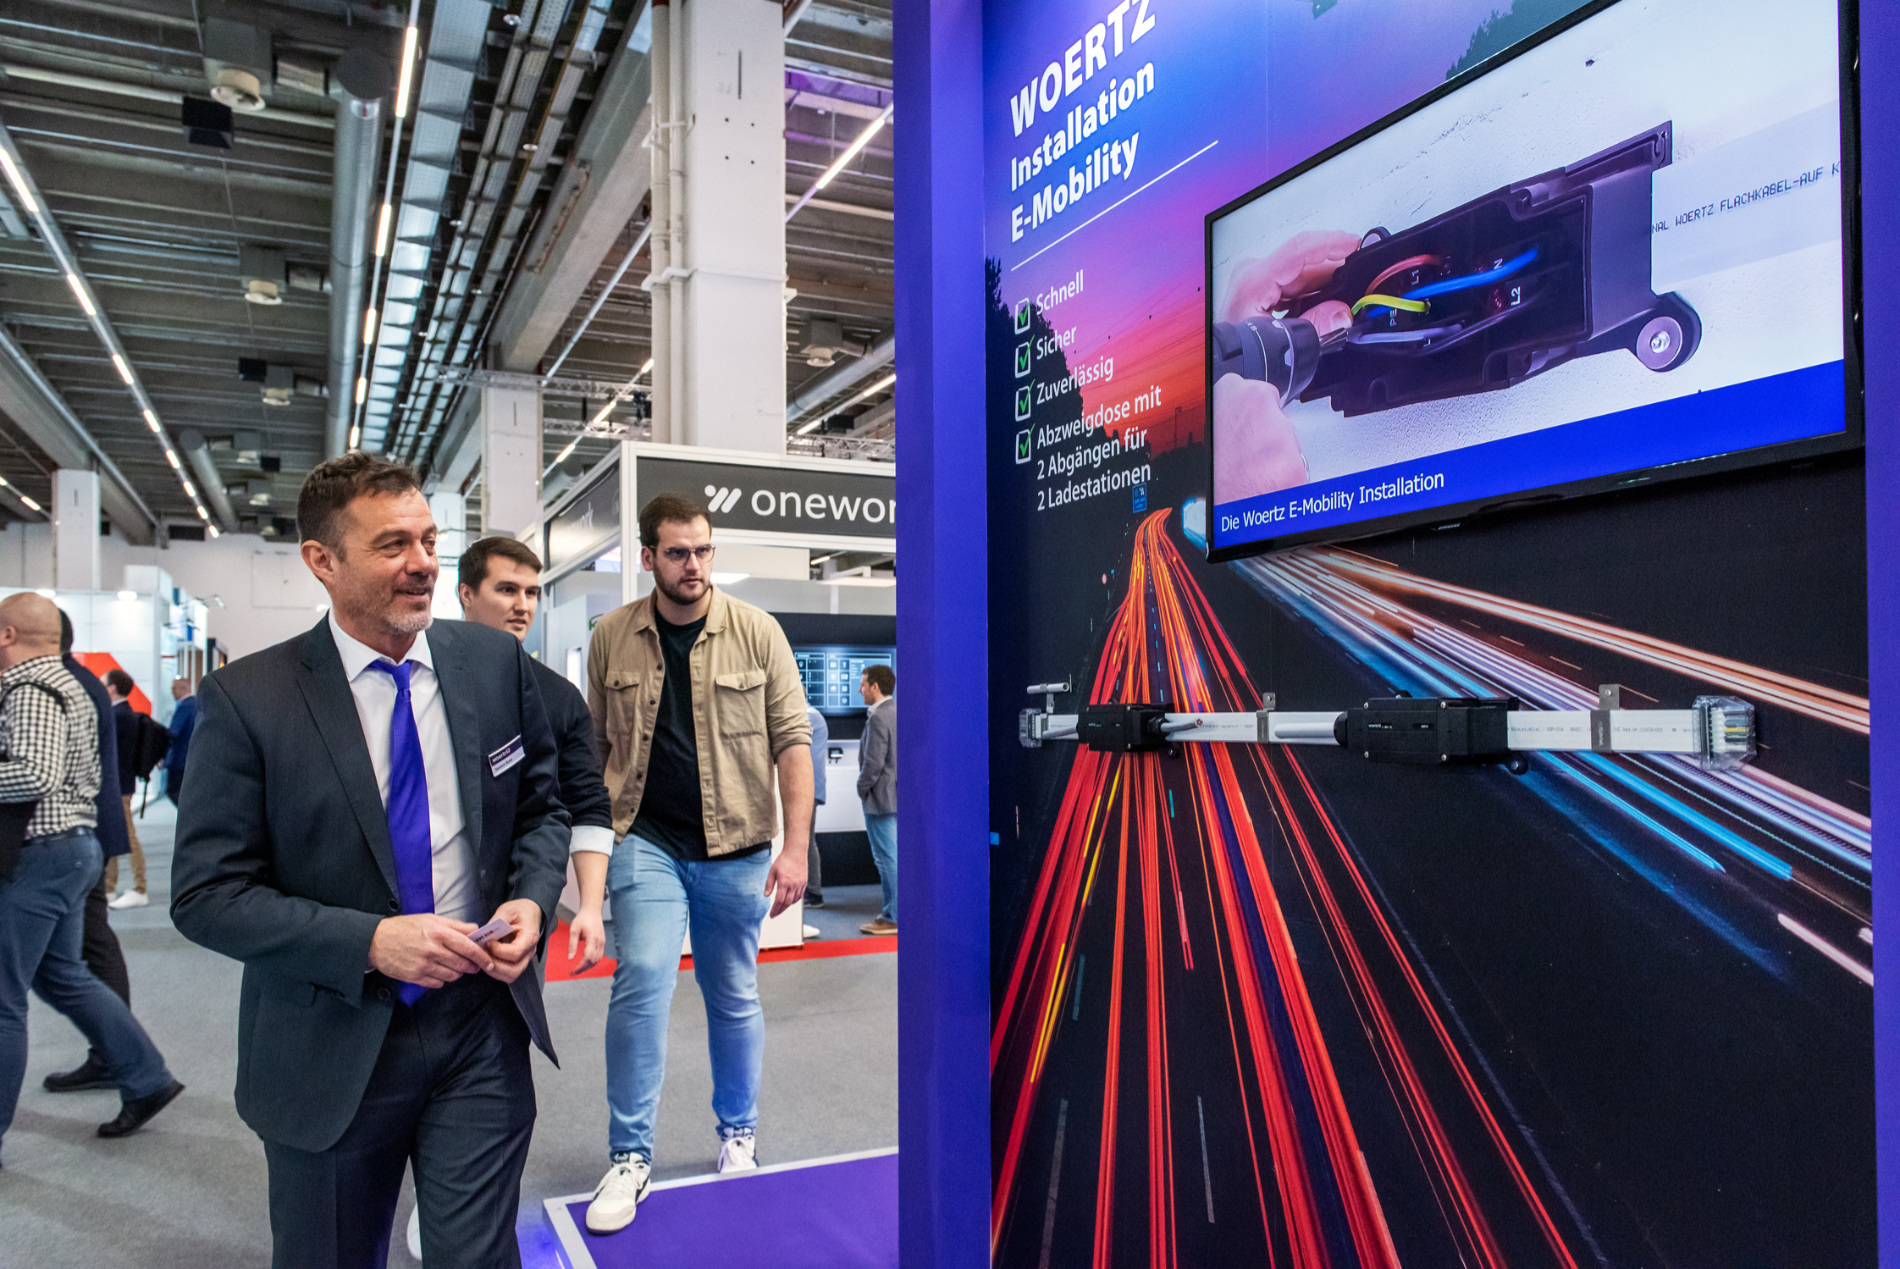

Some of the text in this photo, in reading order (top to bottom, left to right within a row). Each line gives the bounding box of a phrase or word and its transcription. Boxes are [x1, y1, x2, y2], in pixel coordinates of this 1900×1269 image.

[1010, 0, 1156, 138] WOERTZ
[1011, 62, 1154, 192] Installation
[1011, 132, 1139, 243] E-Mobility
[1676, 203, 1714, 225] WOERTZ
[1720, 167, 1823, 212] FLACHKABEL-AUF
[1036, 269, 1084, 316] Schnell
[1510, 286, 1521, 306] L2
[1036, 325, 1077, 360] Sicher
[1036, 355, 1114, 405] Zuverlässig
[1037, 385, 1162, 450] Abzweigdose mit
[1037, 426, 1147, 480] 2 Abgängen für
[1037, 490, 1045, 511] 2
[1048, 463, 1151, 509] Ladestationen
[1221, 471, 1445, 532] Die Woertz E-Mobility Installation
